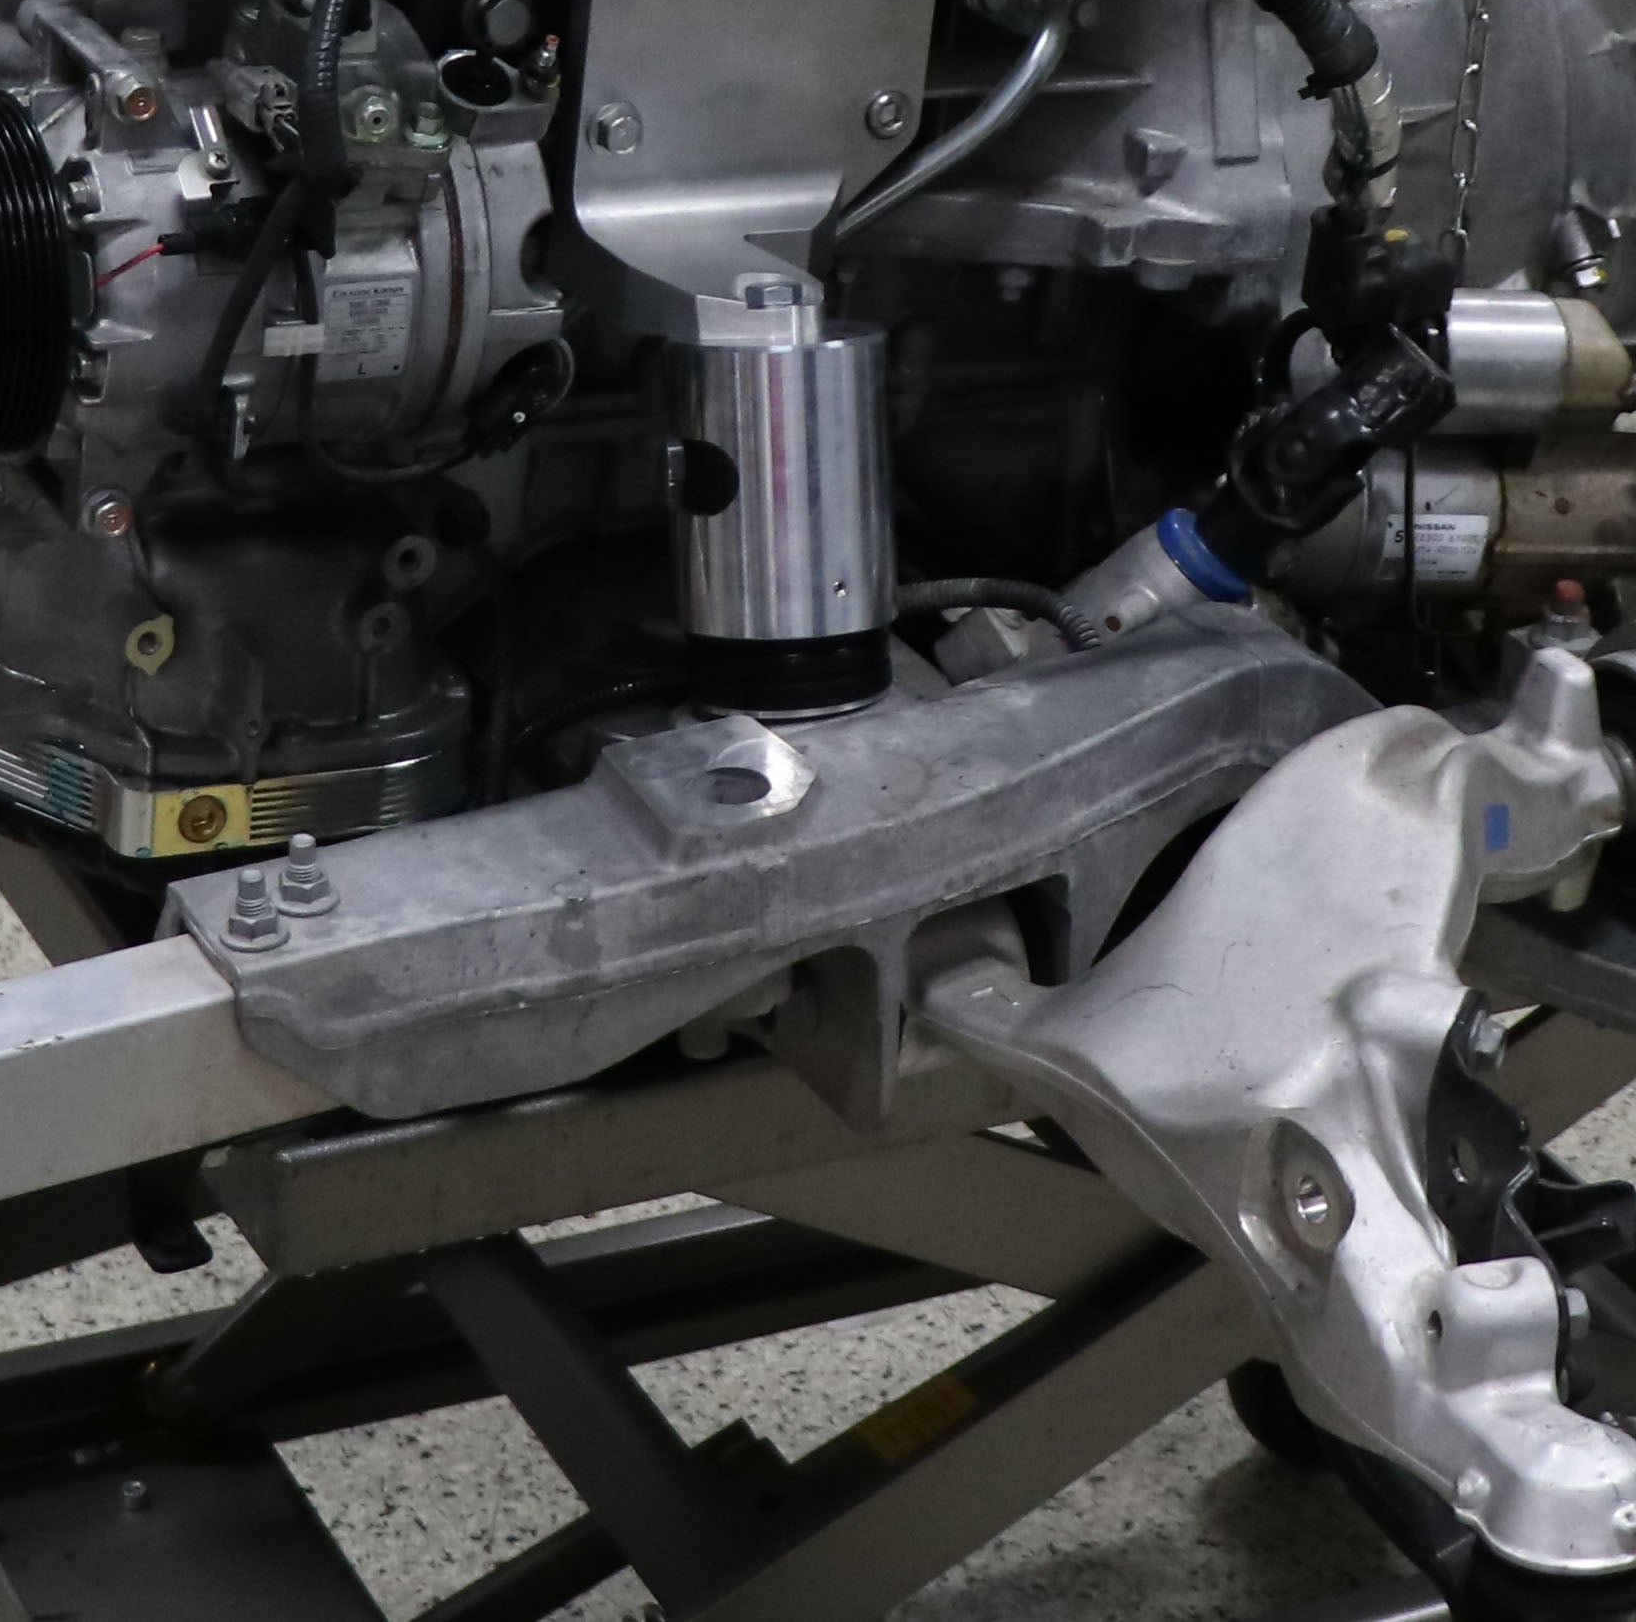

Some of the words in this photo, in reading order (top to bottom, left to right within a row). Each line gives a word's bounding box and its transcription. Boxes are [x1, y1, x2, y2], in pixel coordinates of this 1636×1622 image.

[357, 362, 367, 375] L
[1414, 522, 1456, 531] NISSAN
[1394, 530, 1404, 543] 5
